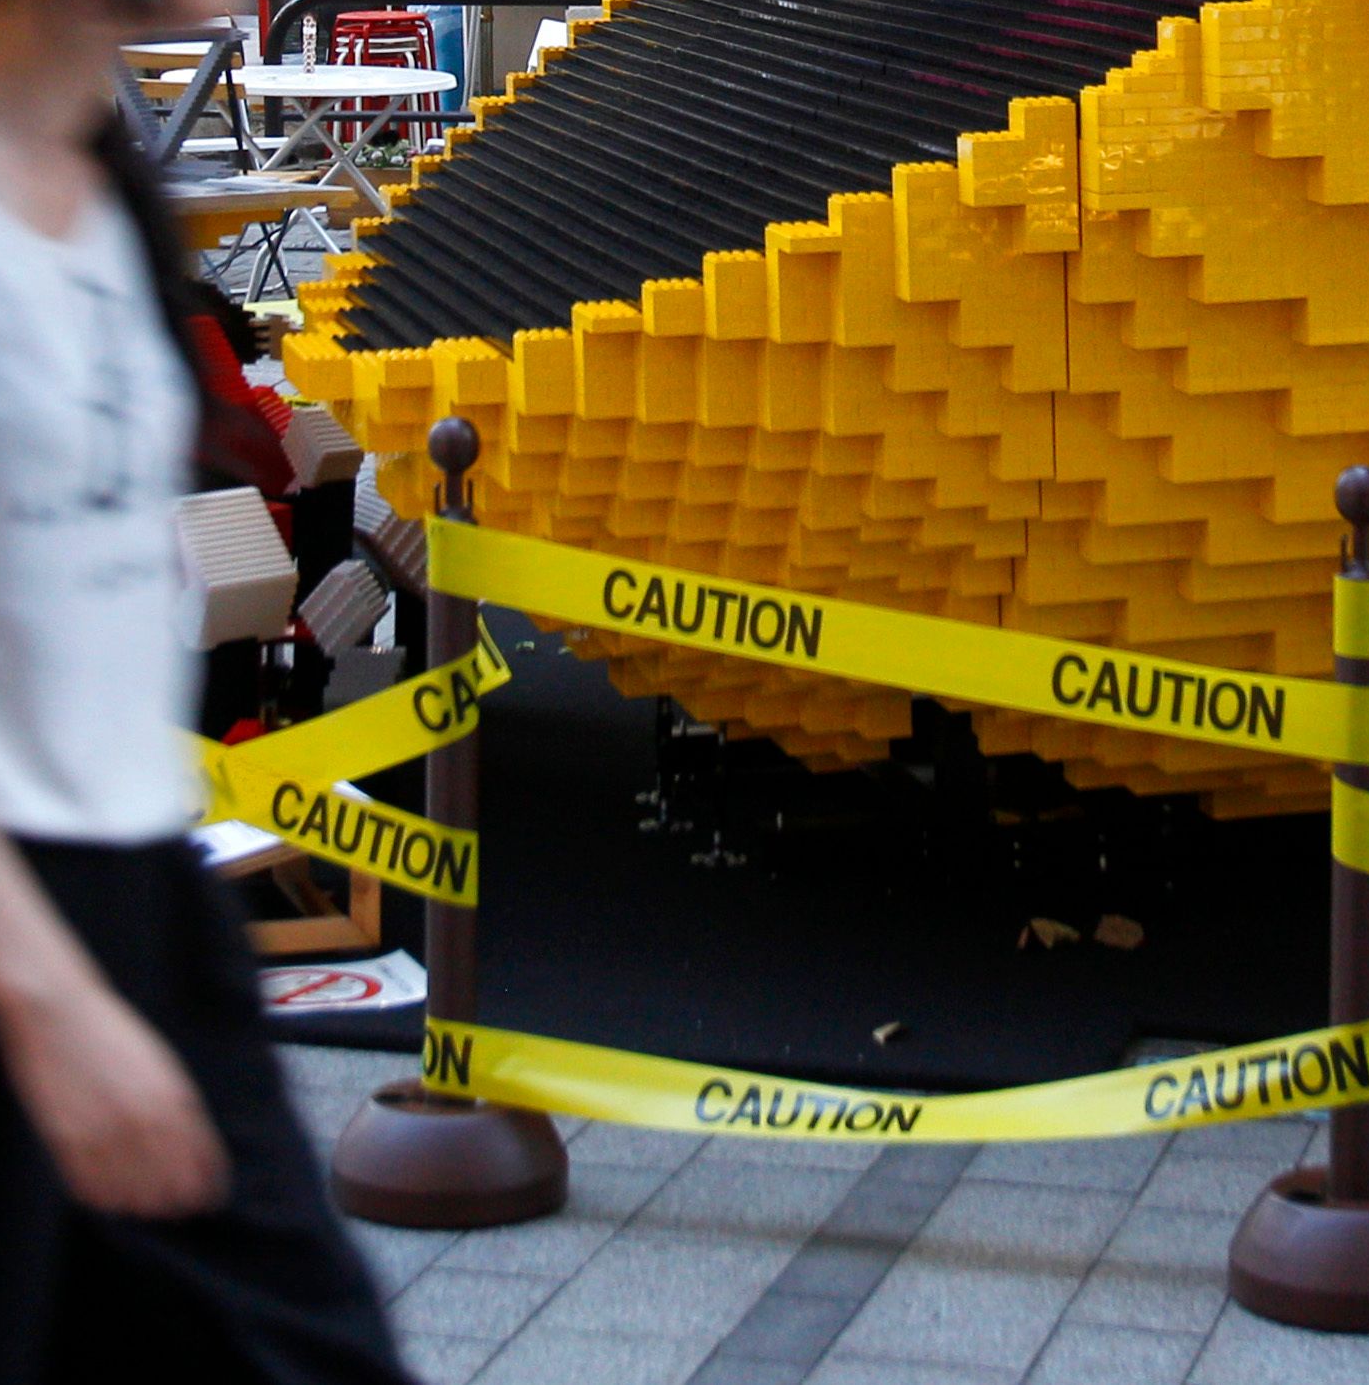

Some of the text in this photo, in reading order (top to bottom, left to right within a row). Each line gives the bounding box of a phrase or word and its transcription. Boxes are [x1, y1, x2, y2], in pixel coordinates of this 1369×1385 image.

[603, 569, 1286, 741] CAUTION CAUTION
[271, 780, 471, 893] CAUTION
[694, 1075, 924, 1134] CAUTION
